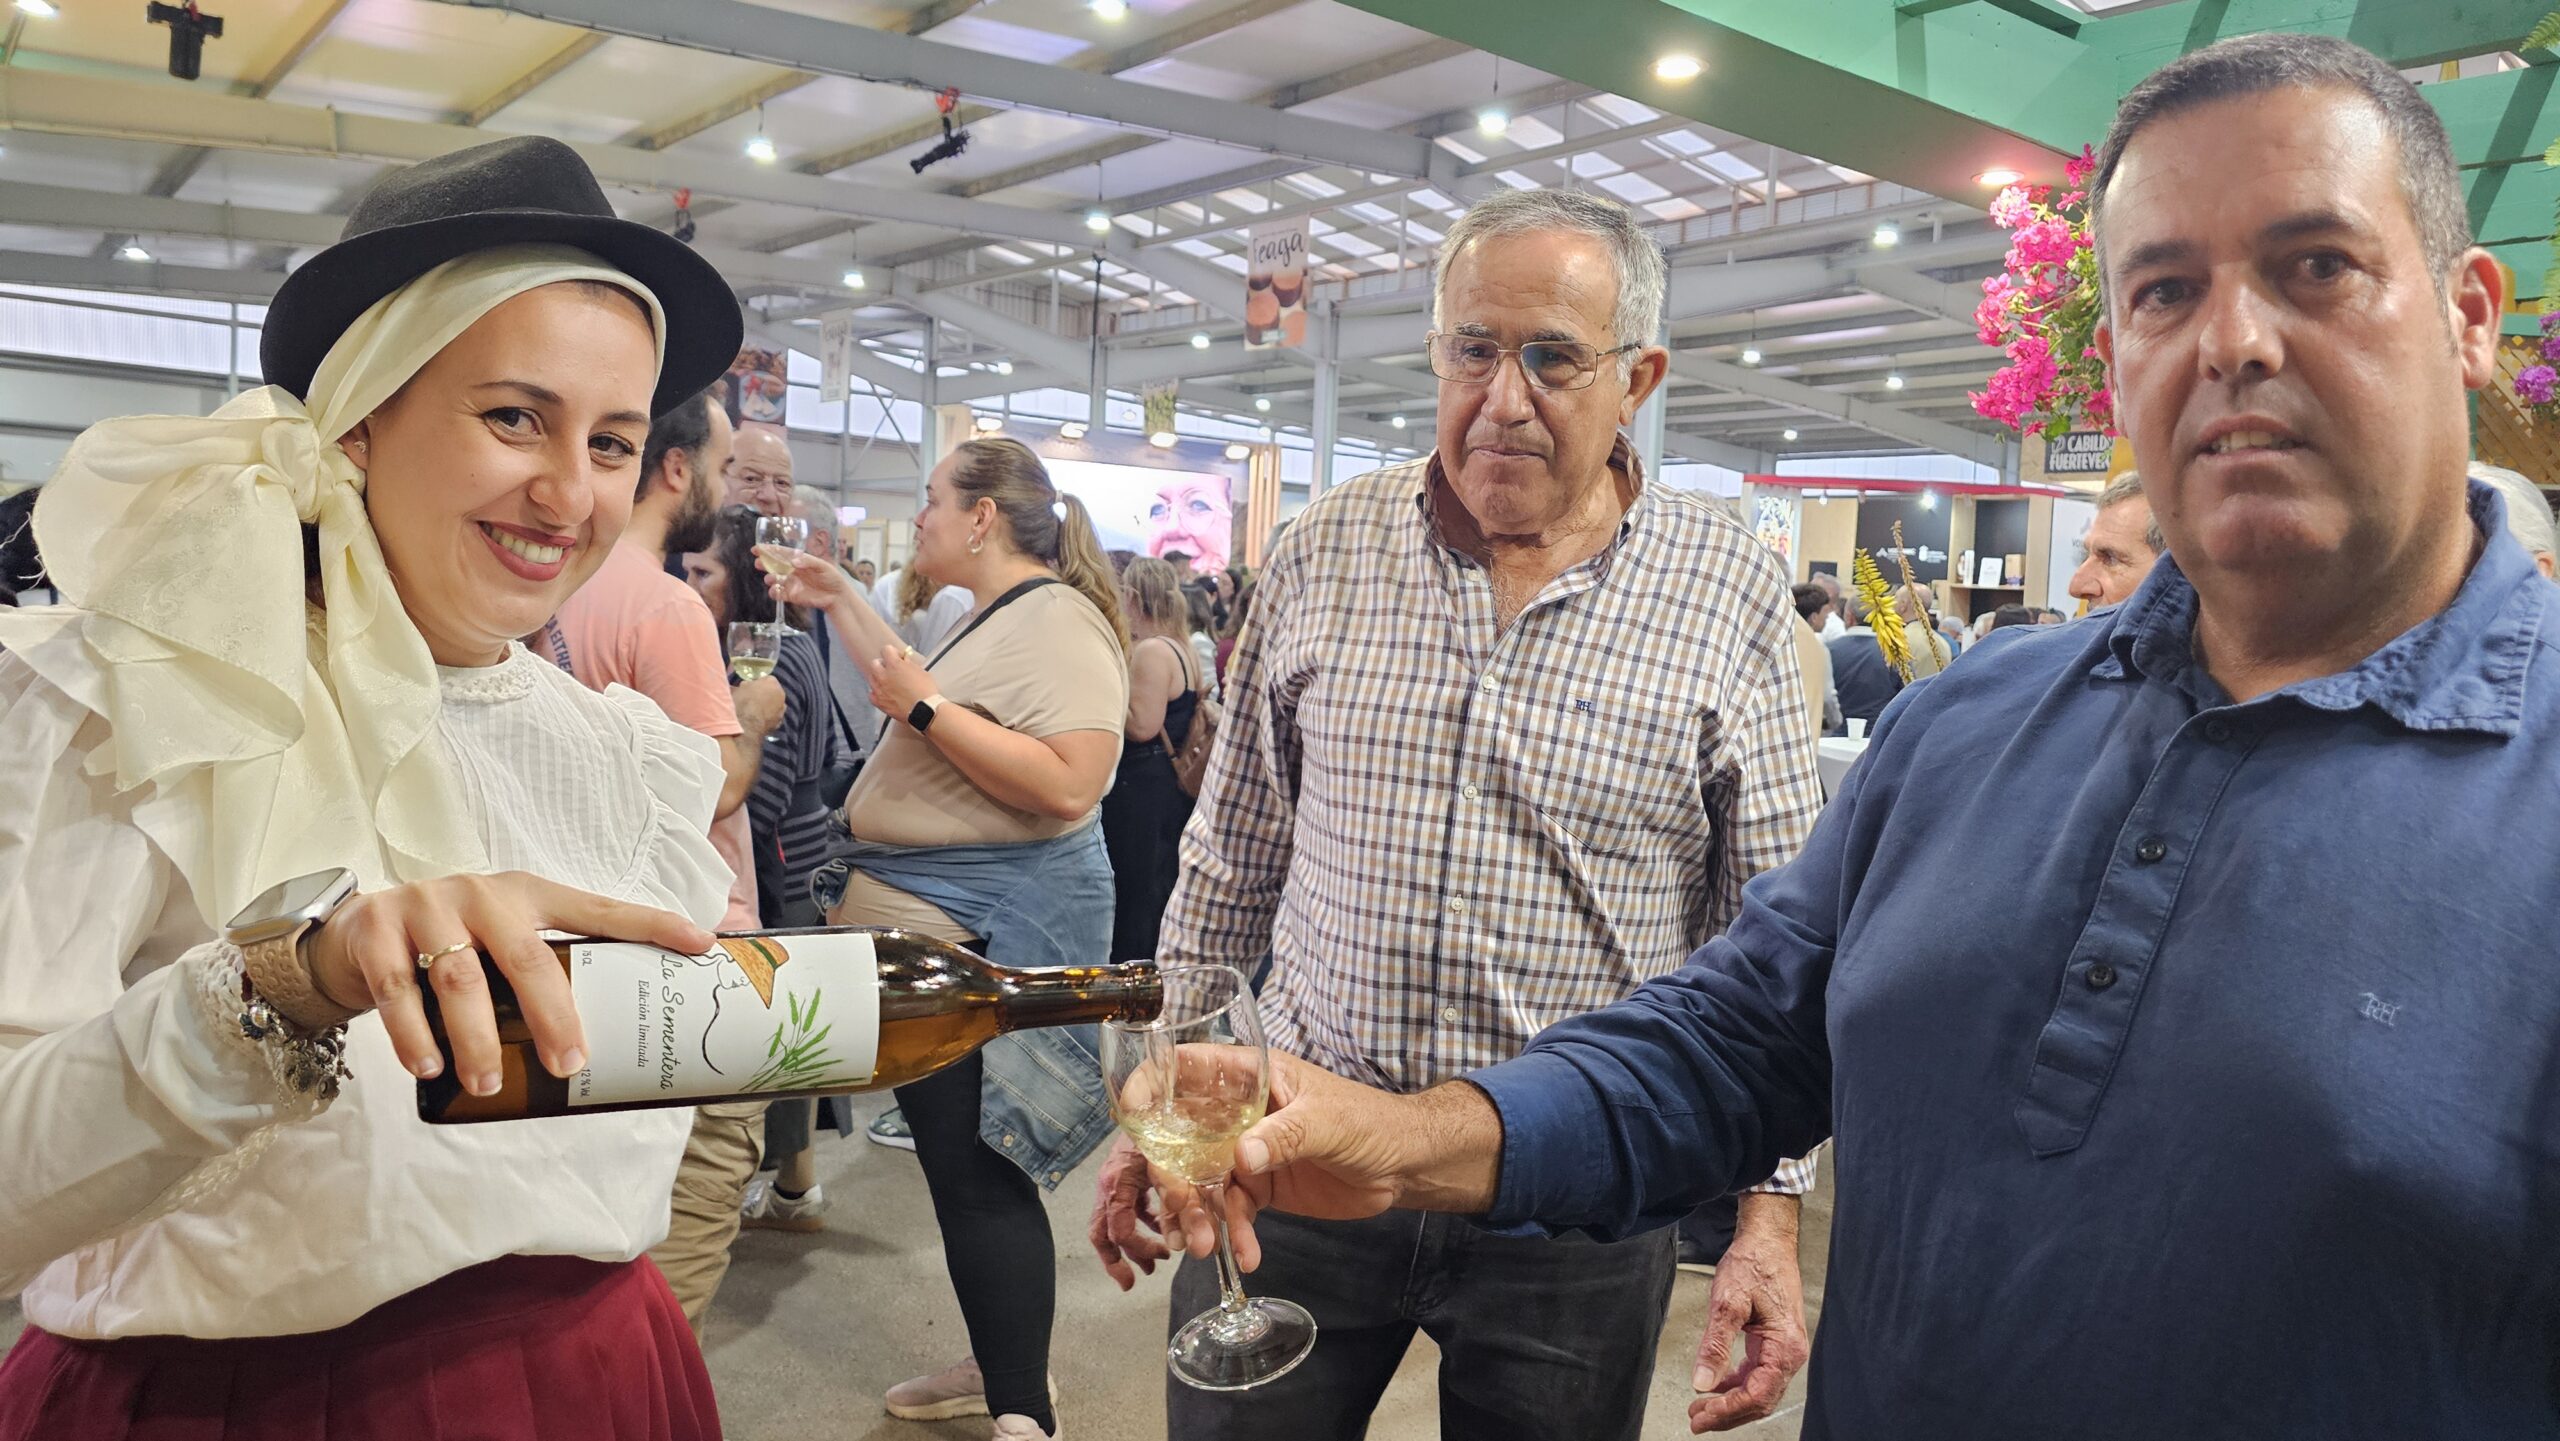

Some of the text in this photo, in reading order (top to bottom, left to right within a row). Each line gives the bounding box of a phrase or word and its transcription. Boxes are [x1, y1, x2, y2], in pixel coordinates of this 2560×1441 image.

[2049, 451, 2109, 471] FUERTEVE
[637, 979, 650, 1067] Edición limitada
[660, 955, 684, 1090] La Sementera
